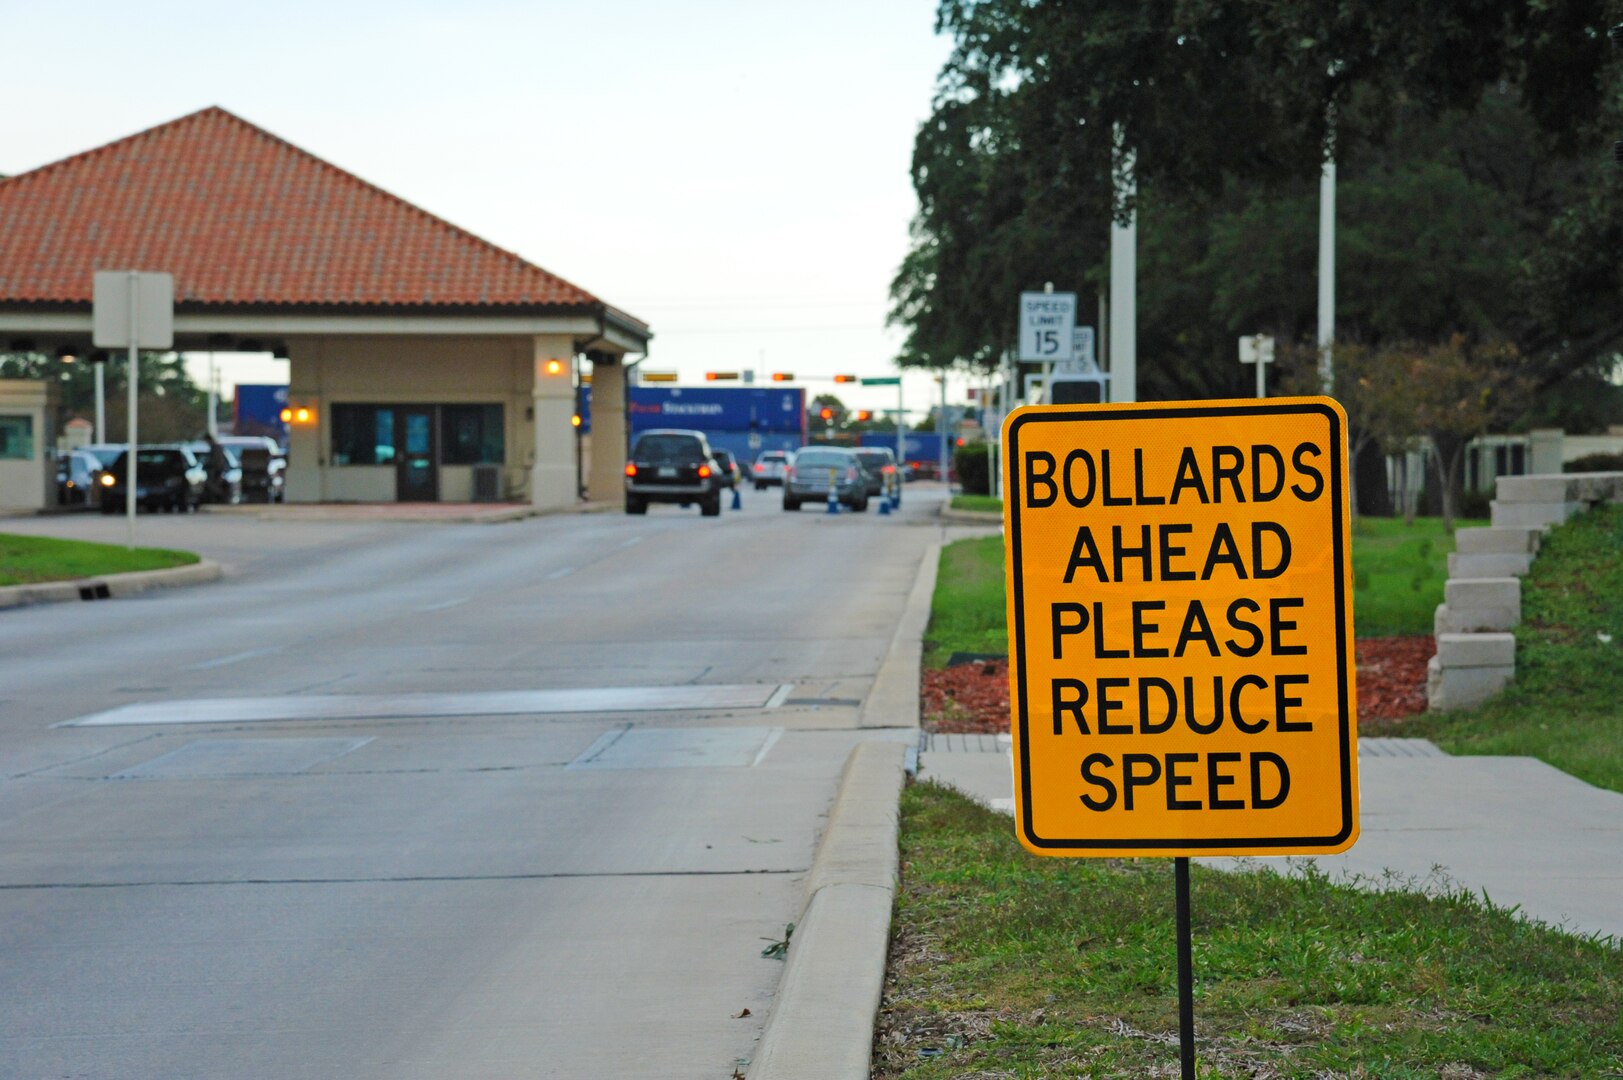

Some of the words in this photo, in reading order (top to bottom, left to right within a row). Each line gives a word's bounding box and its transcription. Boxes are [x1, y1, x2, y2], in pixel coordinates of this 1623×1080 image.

[1027, 302, 1070, 313] SPEED
[1029, 316, 1063, 326] LIMIT
[1036, 331, 1059, 355] 15
[1026, 442, 1324, 508] BOLLARDS
[1063, 522, 1292, 583] AHEAD
[1052, 598, 1307, 659] PLEASE
[1052, 674, 1313, 735] REDUCE
[1080, 752, 1291, 812] SPEED
